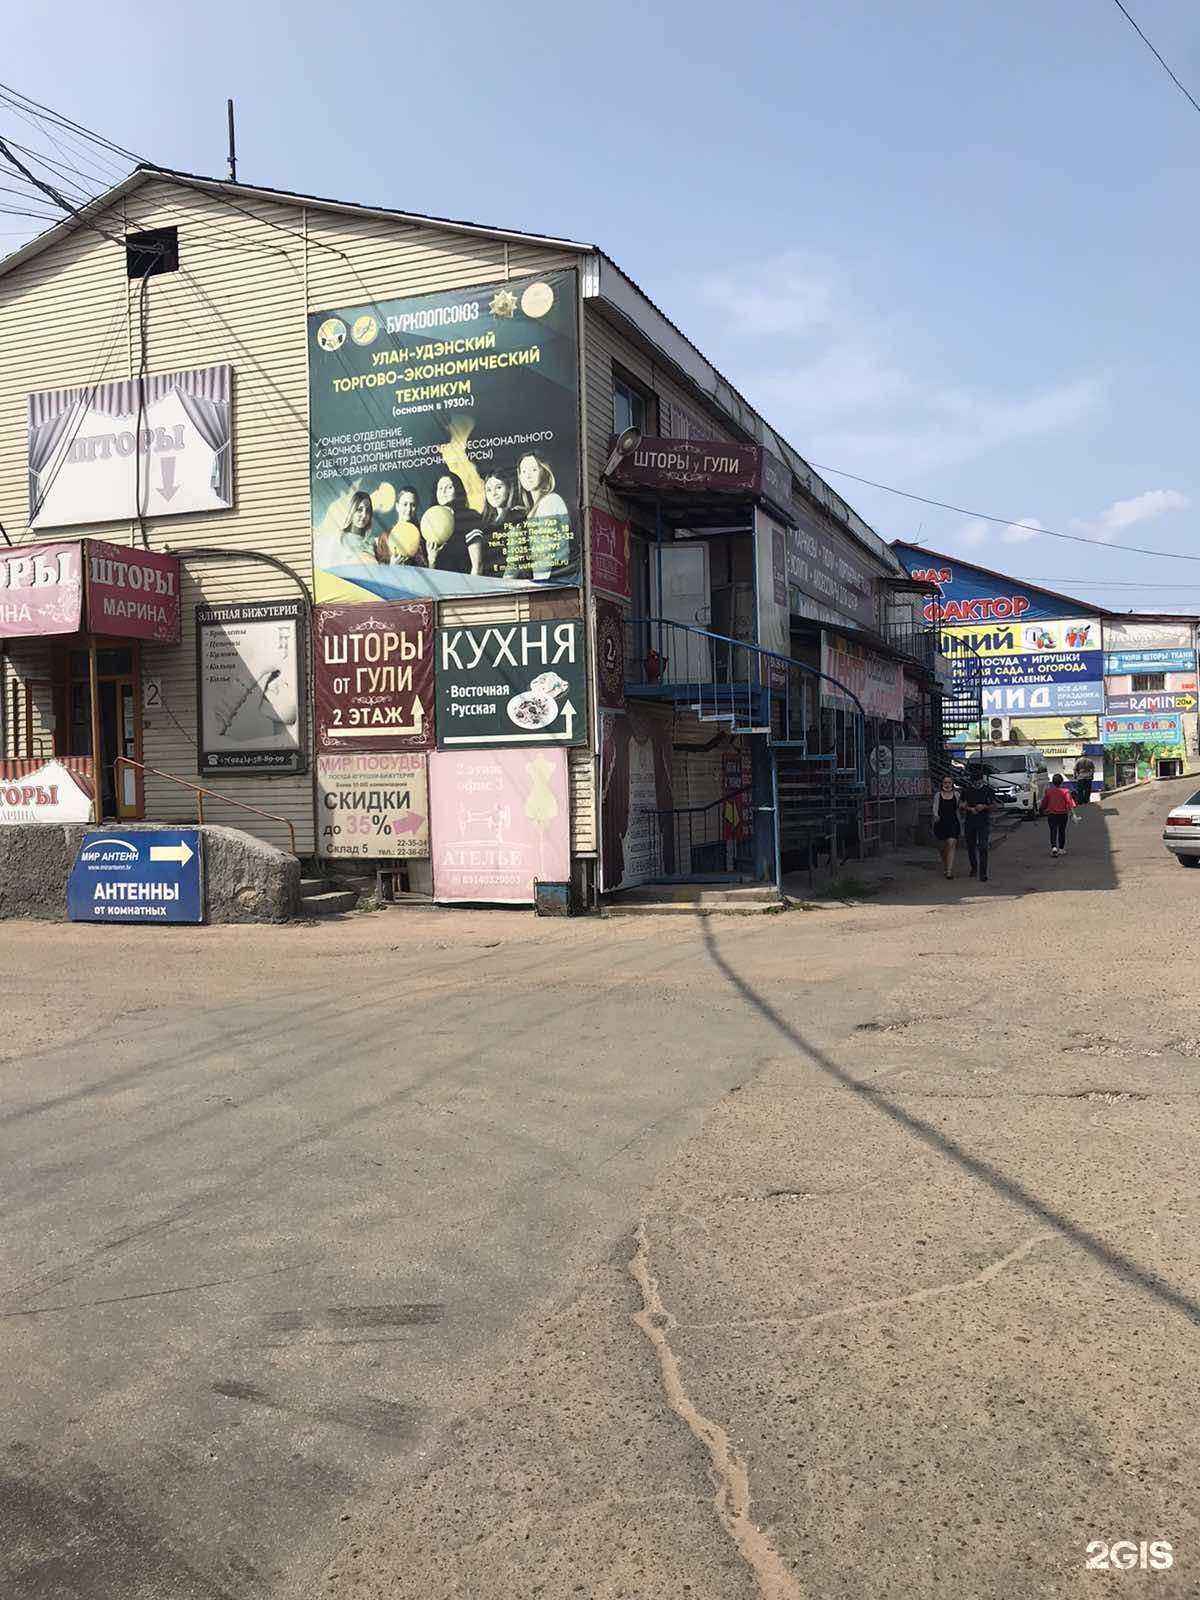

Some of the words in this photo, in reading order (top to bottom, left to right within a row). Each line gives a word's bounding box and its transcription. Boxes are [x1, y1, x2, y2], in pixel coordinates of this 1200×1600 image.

[386, 301, 479, 334] БУРКООПСОЮЗ
[371, 331, 496, 367] УЛАН-УДЭНСКИЙ
[333, 346, 541, 393] ТОРГОВО-ЭКОНОМИЧЕСКИЙ
[395, 380, 471, 404] ТЕХНИКУМ
[392, 403, 434, 417] (основан
[67, 425, 186, 464] ШТОРЫ
[321, 434, 352, 446] ОЧНОЕ
[353, 427, 403, 442] ОТДЕЛЕНИЕ
[322, 444, 362, 457] ЗАОЧНОЕ
[363, 436, 413, 451] ОТДЕЛЕНИЕ
[316, 464, 377, 480] ОБРАЗОВАНИЯ
[379, 456, 447, 473] (КРАТКОСРОЧН
[465, 448, 494, 461] УРСЫ)
[322, 456, 349, 468] ЦЕНТР
[349, 444, 440, 466] ДОПОЛНИТЕЛЬНОГО
[633, 451, 690, 470] ШТОРЫ
[692, 462, 700, 471] у
[703, 456, 740, 474] ГУЛИ
[90, 557, 175, 596] ШТОРЫ
[103, 597, 168, 623] МАРИНА
[242, 604, 298, 618] БИЖУТЕРИЯ
[923, 596, 1030, 621] ФАКТОР
[324, 630, 424, 664] ШТОРЫ
[442, 623, 575, 671] КУХНЯ
[1031, 652, 1080, 665] ИГРУШКИ
[356, 665, 413, 693] ГУЛИ
[994, 665, 1025, 676] САДА
[1038, 662, 1087, 673] ОГОРОДА
[1012, 673, 1054, 684] КЛЕЕНКА
[147, 684, 159, 706] 2
[450, 684, 510, 698] Восточная
[451, 703, 496, 717] Русская
[1130, 695, 1175, 710] RAMIN
[333, 708, 343, 725] 2
[349, 706, 403, 725] ЭТАЖ
[320, 757, 351, 771] МИР
[357, 755, 425, 771] ПОСУДЫ
[324, 790, 411, 812] СКИДКИ
[323, 825, 341, 836] до
[81, 851, 100, 861] МИР
[101, 851, 139, 861] АНТЕНН
[326, 843, 360, 855] Склад
[443, 849, 522, 866] АТЕЛЬЕ
[93, 883, 179, 901] АНТЕННЫ
[94, 907, 106, 916] от
[107, 906, 167, 916] комнатных
